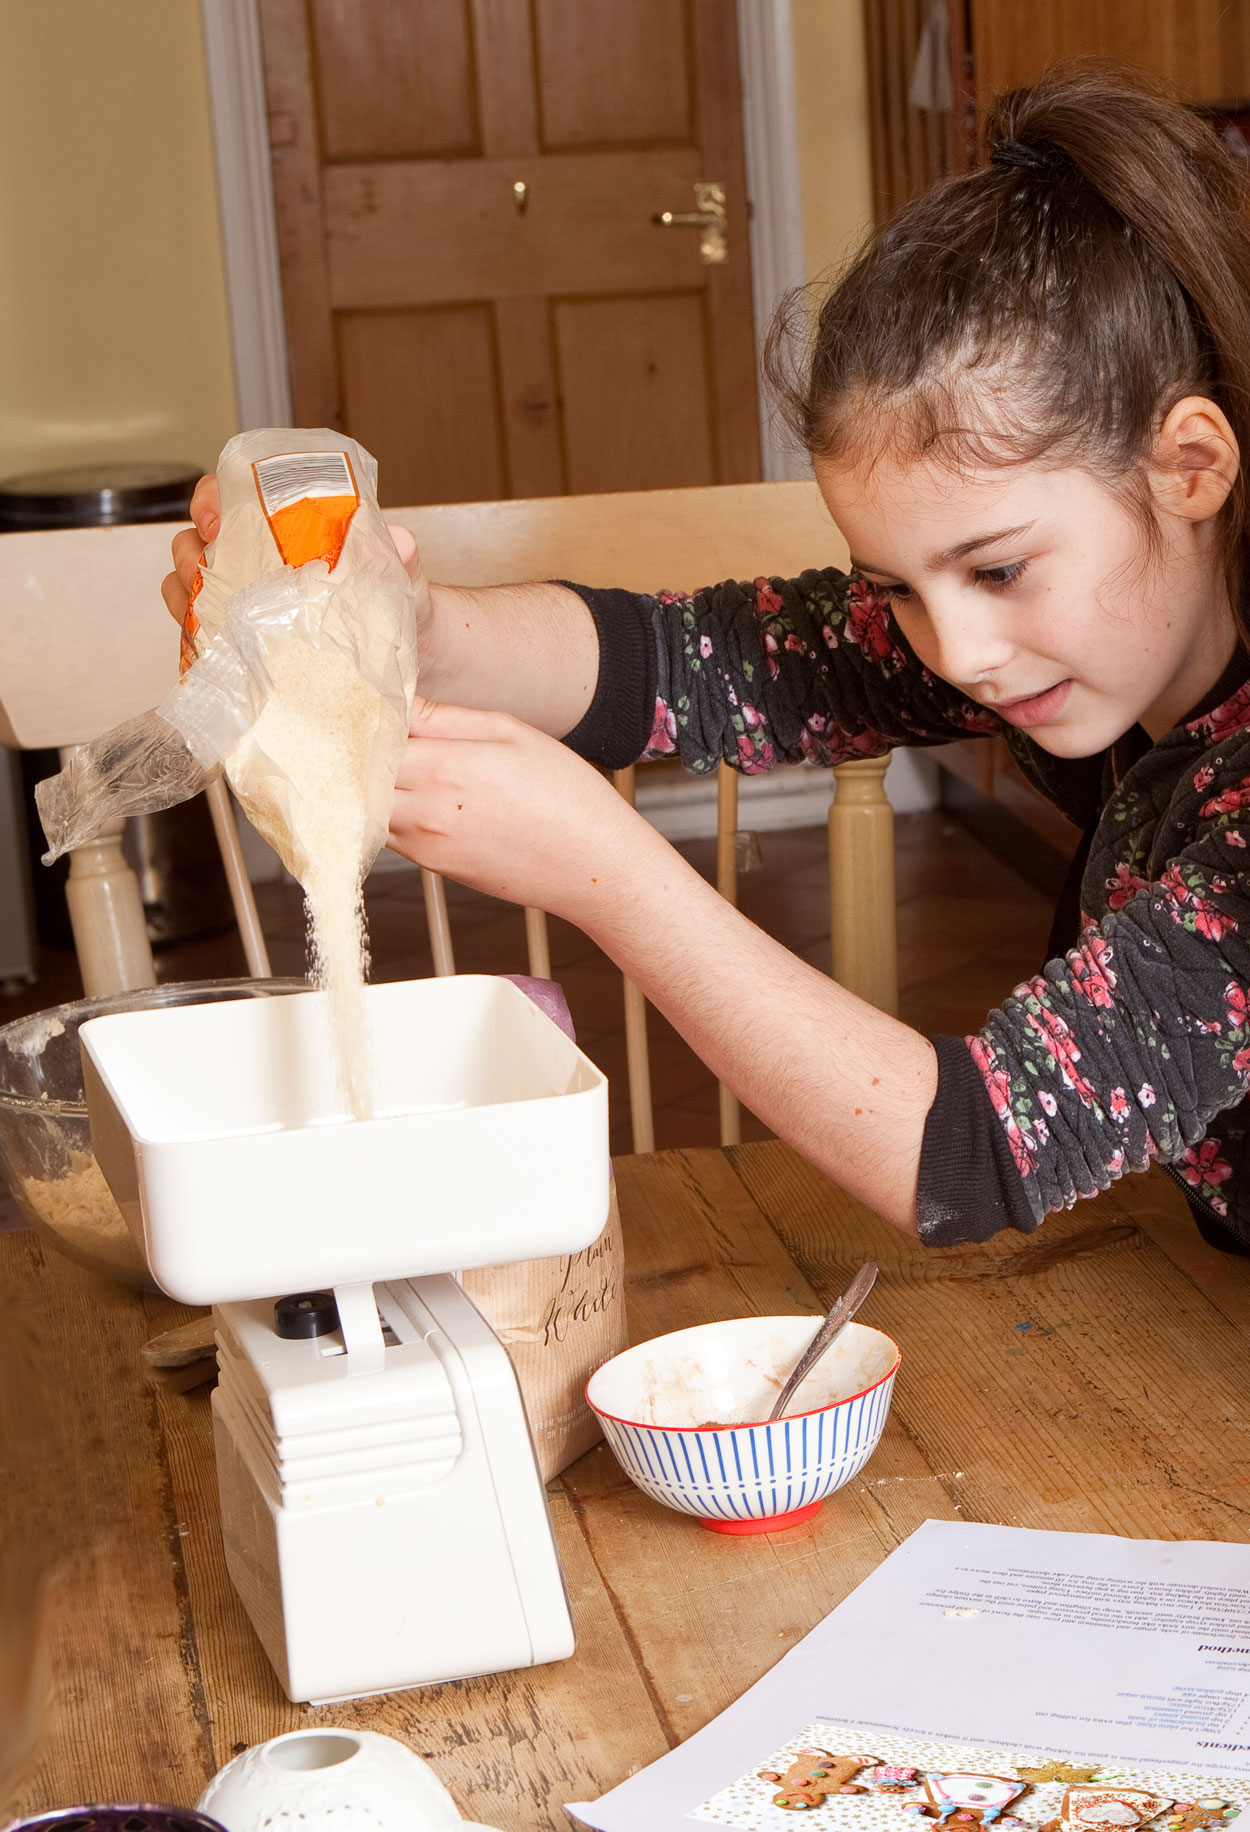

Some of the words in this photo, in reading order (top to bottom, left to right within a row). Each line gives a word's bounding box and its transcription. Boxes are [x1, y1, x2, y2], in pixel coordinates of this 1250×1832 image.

[535, 1418, 555, 1432] FROM
[546, 1430, 556, 1440] ON
[1203, 1659, 1250, 1668] decorations
[1049, 1711, 1077, 1720] rolling
